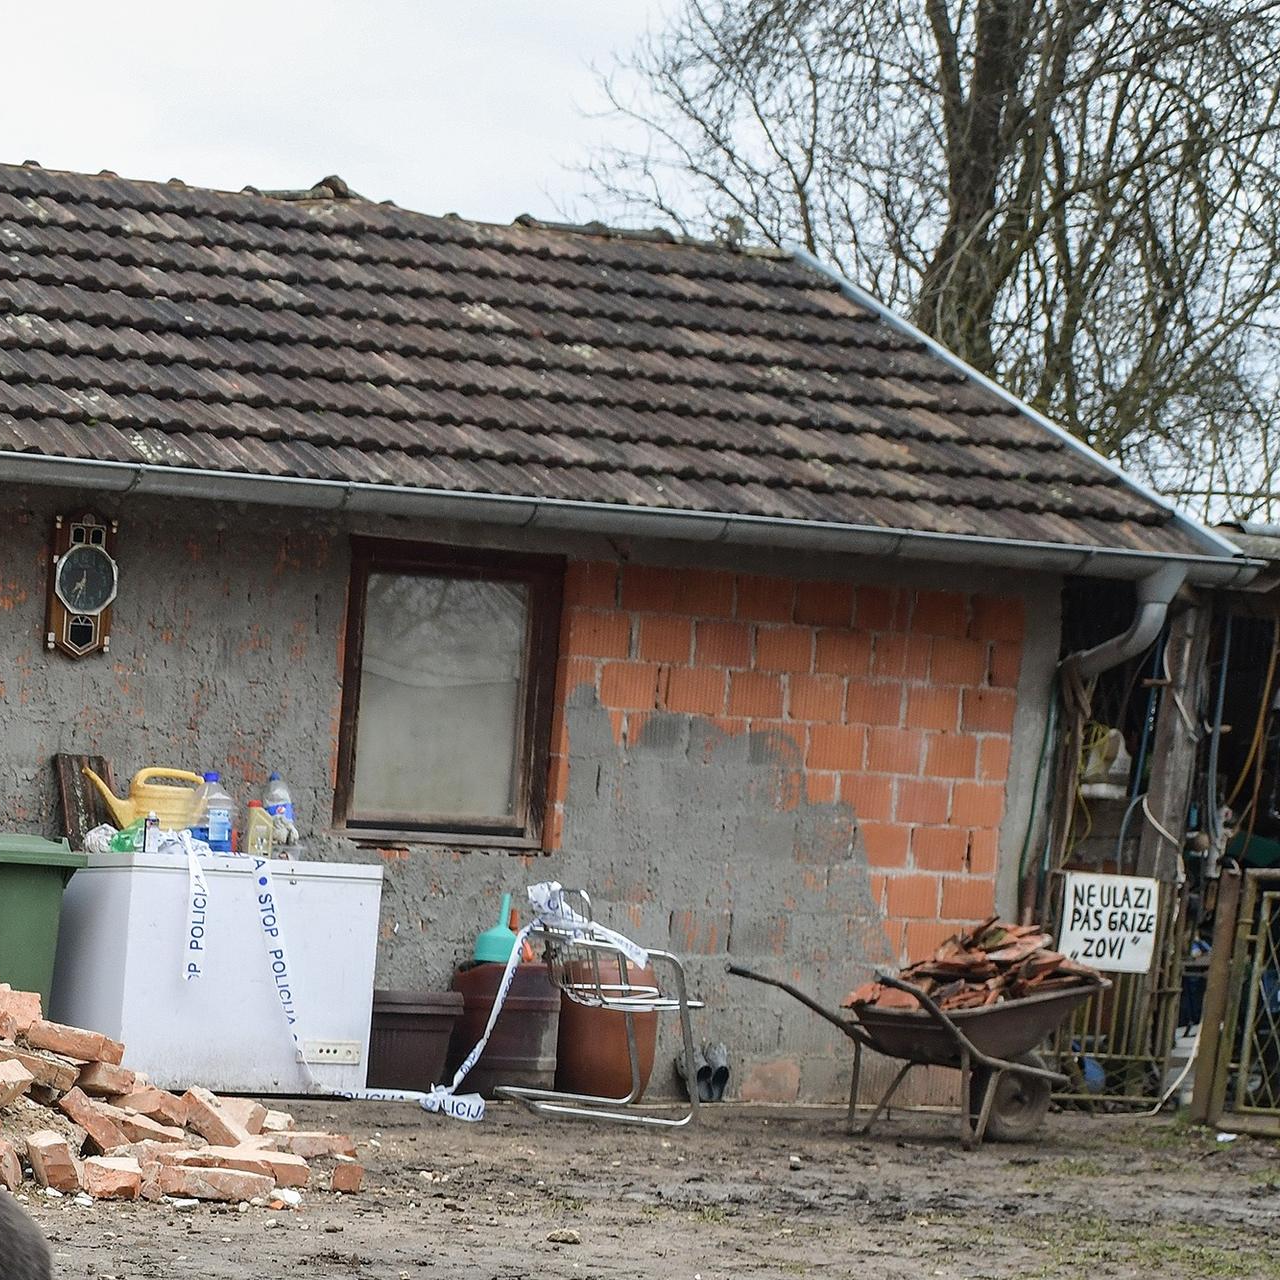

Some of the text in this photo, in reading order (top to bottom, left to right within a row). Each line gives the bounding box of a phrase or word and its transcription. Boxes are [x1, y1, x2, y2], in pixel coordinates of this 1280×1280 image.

[1073, 884, 1151, 910] NE ULAZI
[258, 893, 280, 939] STOP
[1070, 908, 1154, 933] PAS GRIZE
